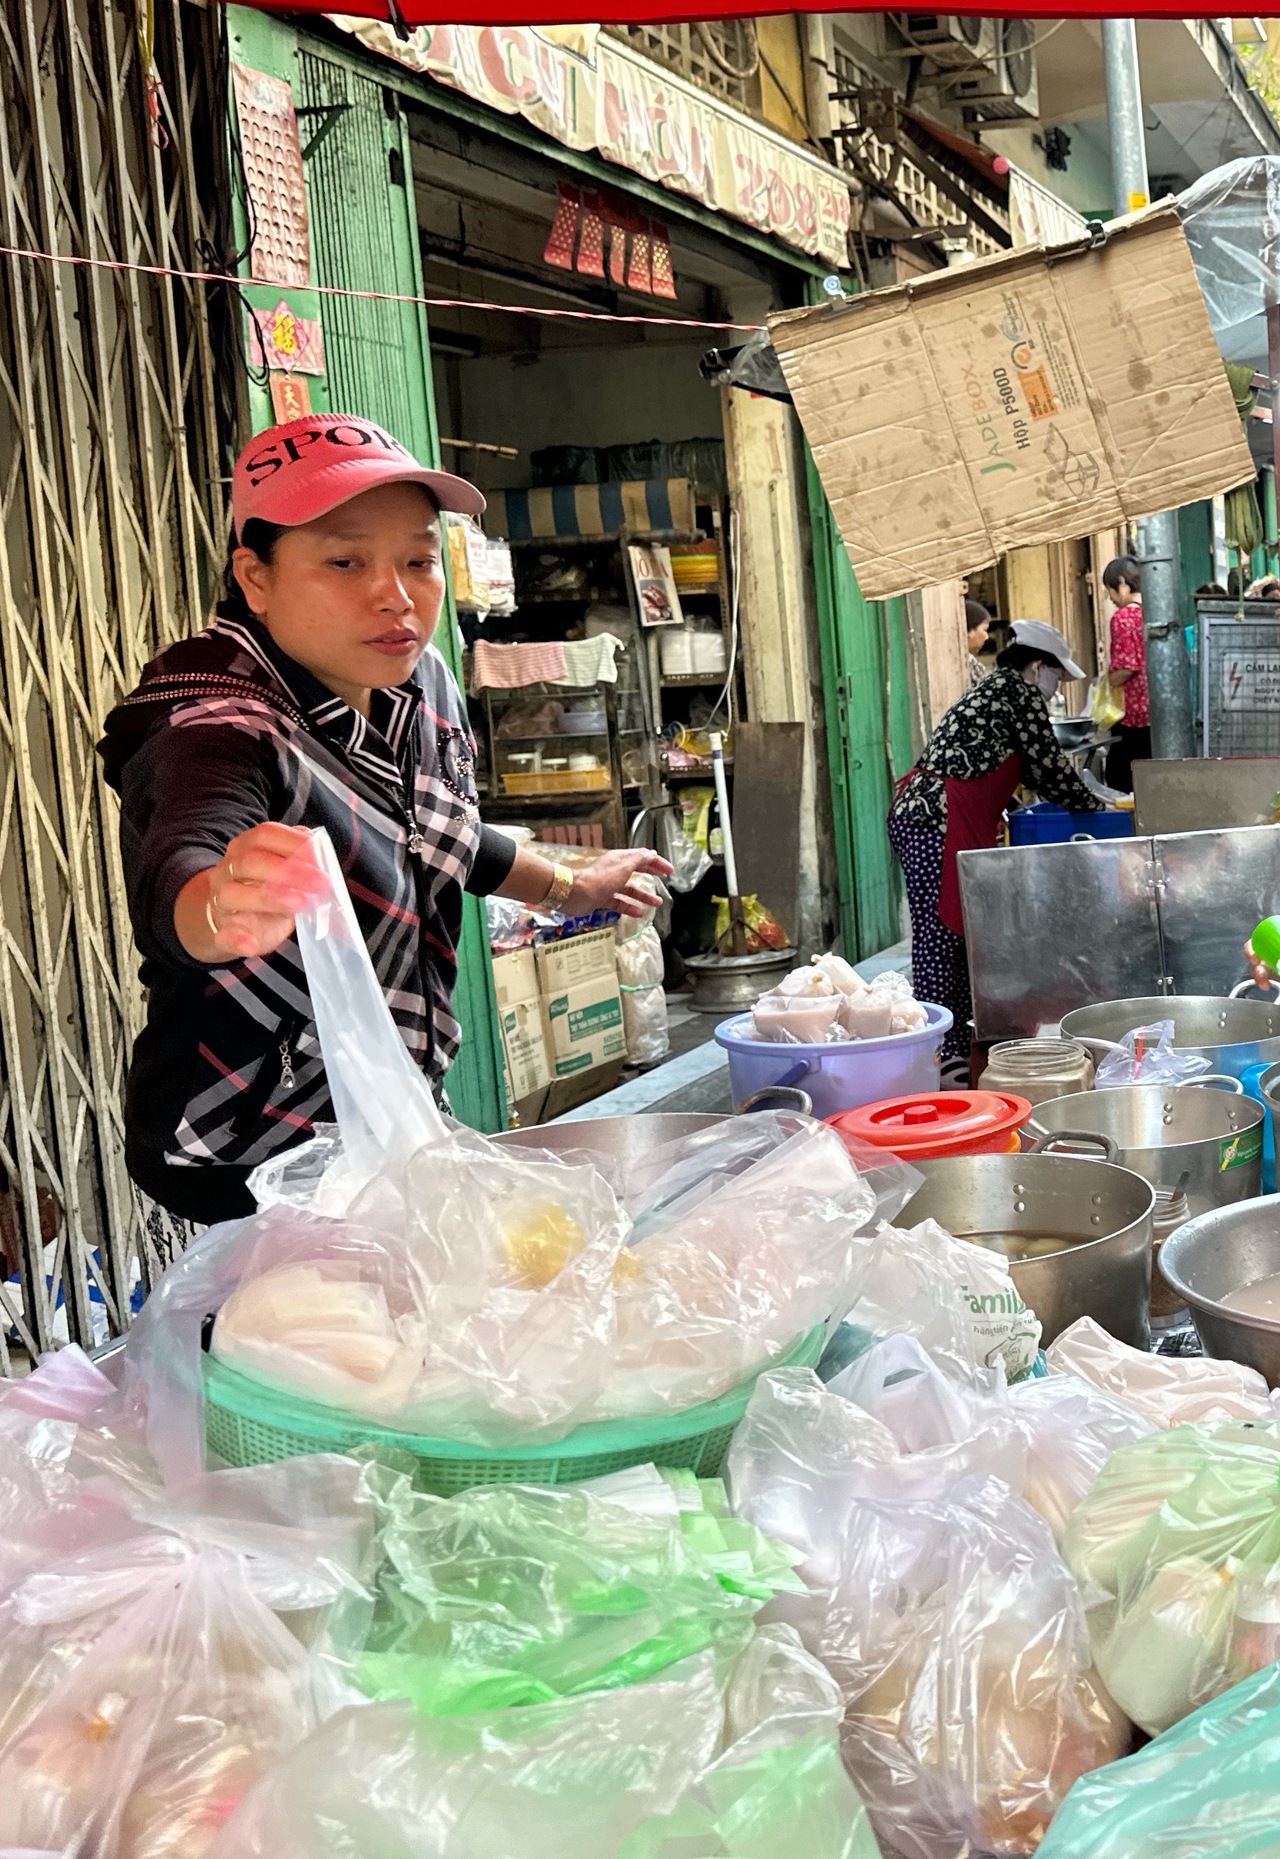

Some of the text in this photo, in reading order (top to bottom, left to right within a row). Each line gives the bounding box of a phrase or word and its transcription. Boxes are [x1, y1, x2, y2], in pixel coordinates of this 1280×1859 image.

[960, 364, 1017, 475] JADE BOX
[992, 367, 1031, 450] Hộp P500D
